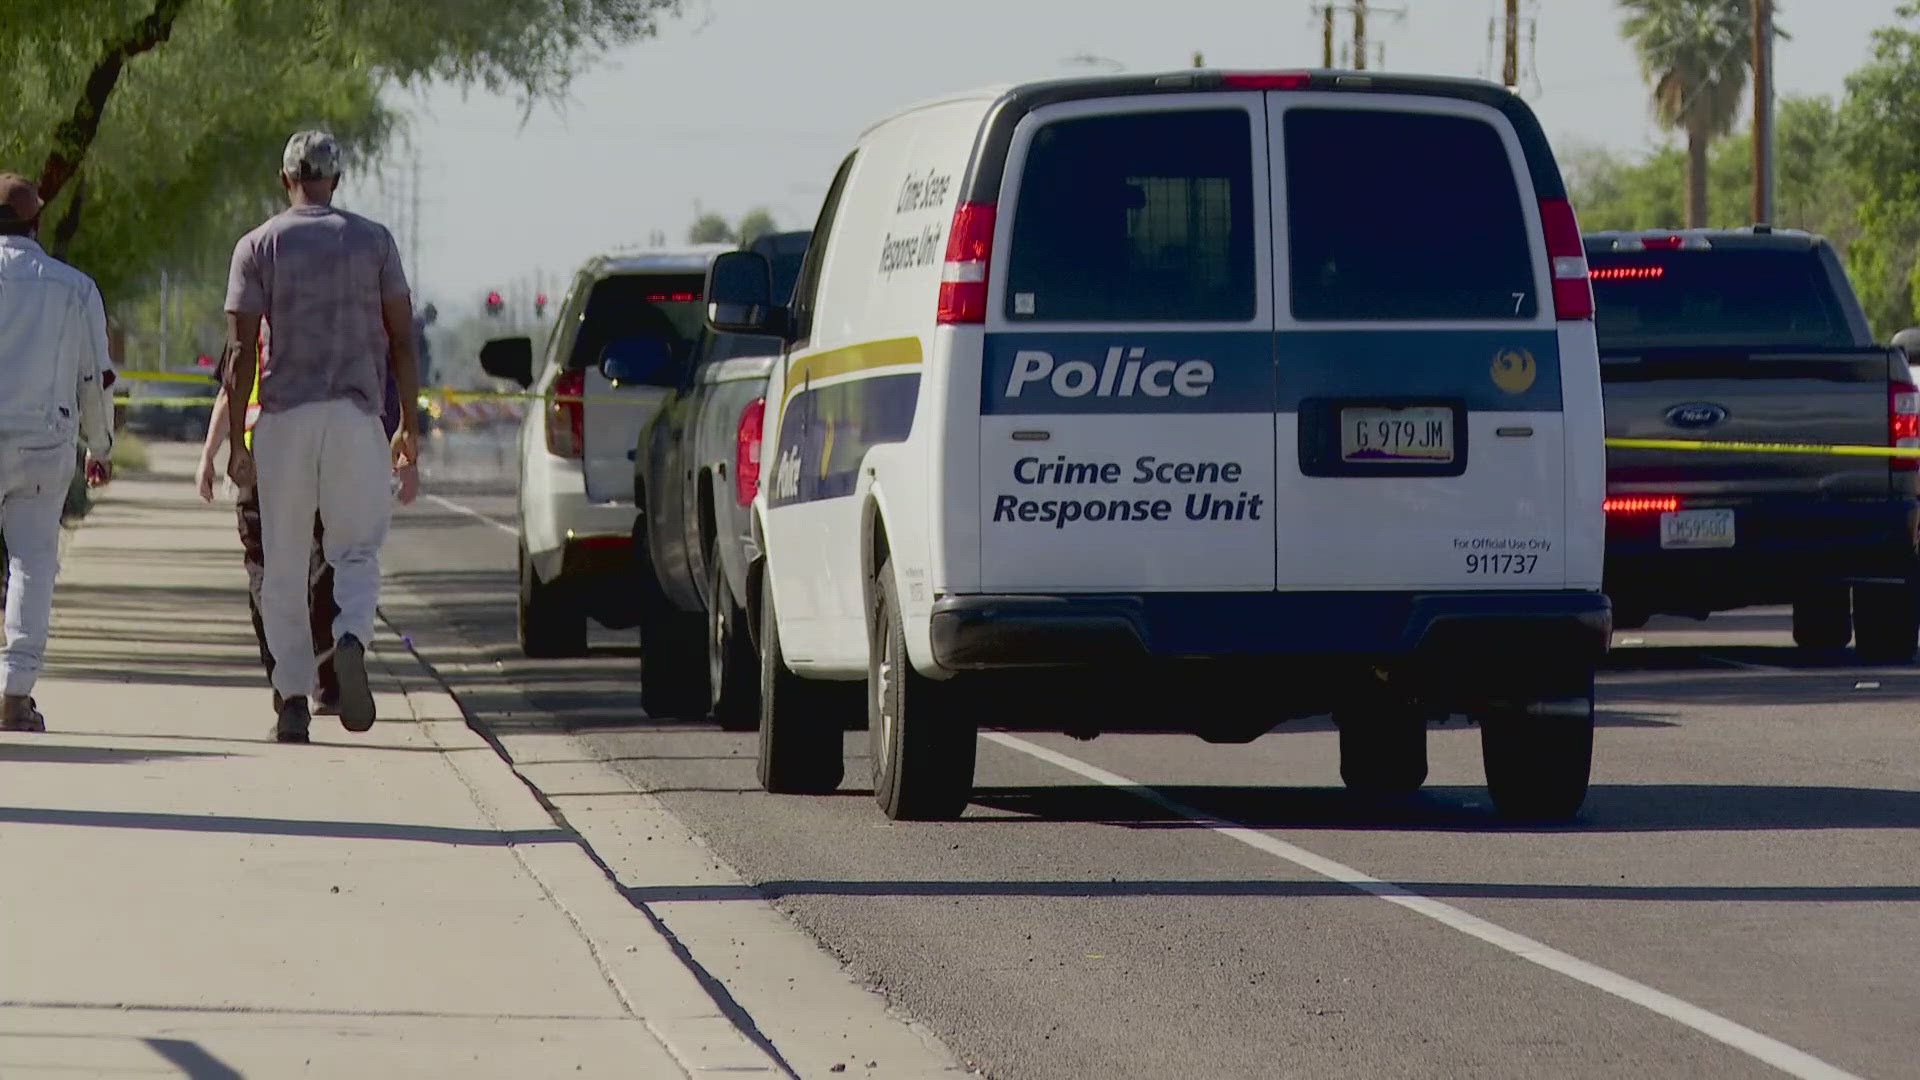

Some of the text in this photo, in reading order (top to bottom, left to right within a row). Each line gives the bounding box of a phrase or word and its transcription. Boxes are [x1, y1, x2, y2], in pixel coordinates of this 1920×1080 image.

[897, 168, 950, 214] Crime Scene
[879, 221, 942, 282] Response Unit
[1511, 291, 1525, 315] 7
[1005, 347, 1215, 398] Police
[1357, 420, 1443, 448] G 979 JM
[1013, 455, 1242, 485] Crime Scene
[993, 491, 1264, 530] Response Unit
[1453, 538, 1552, 552] For Official Use Only
[1466, 554, 1538, 575] 911737
